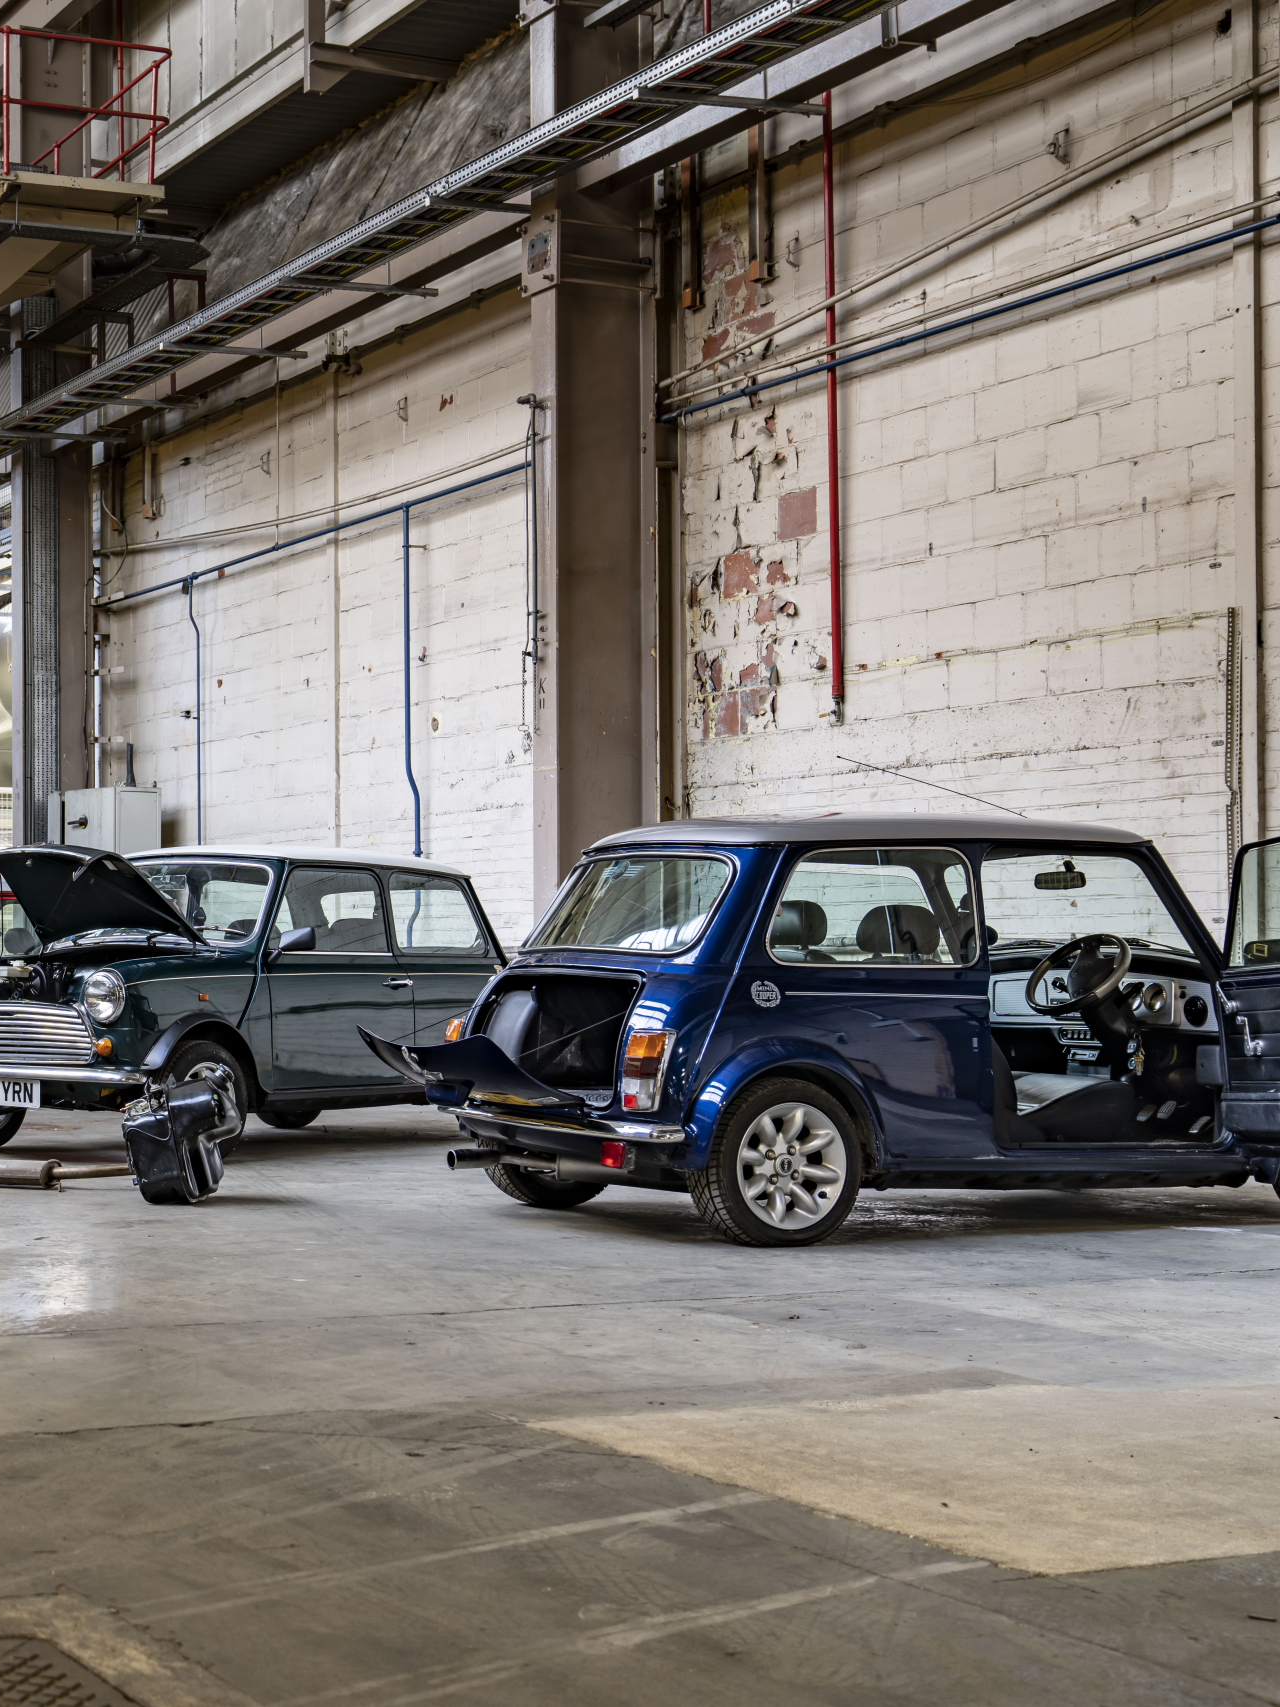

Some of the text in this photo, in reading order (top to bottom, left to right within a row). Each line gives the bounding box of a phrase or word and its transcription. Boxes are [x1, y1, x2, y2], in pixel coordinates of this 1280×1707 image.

[539, 678, 547, 694] K
[756, 992, 776, 1000] COOPER
[2, 1081, 34, 1103] YRN
